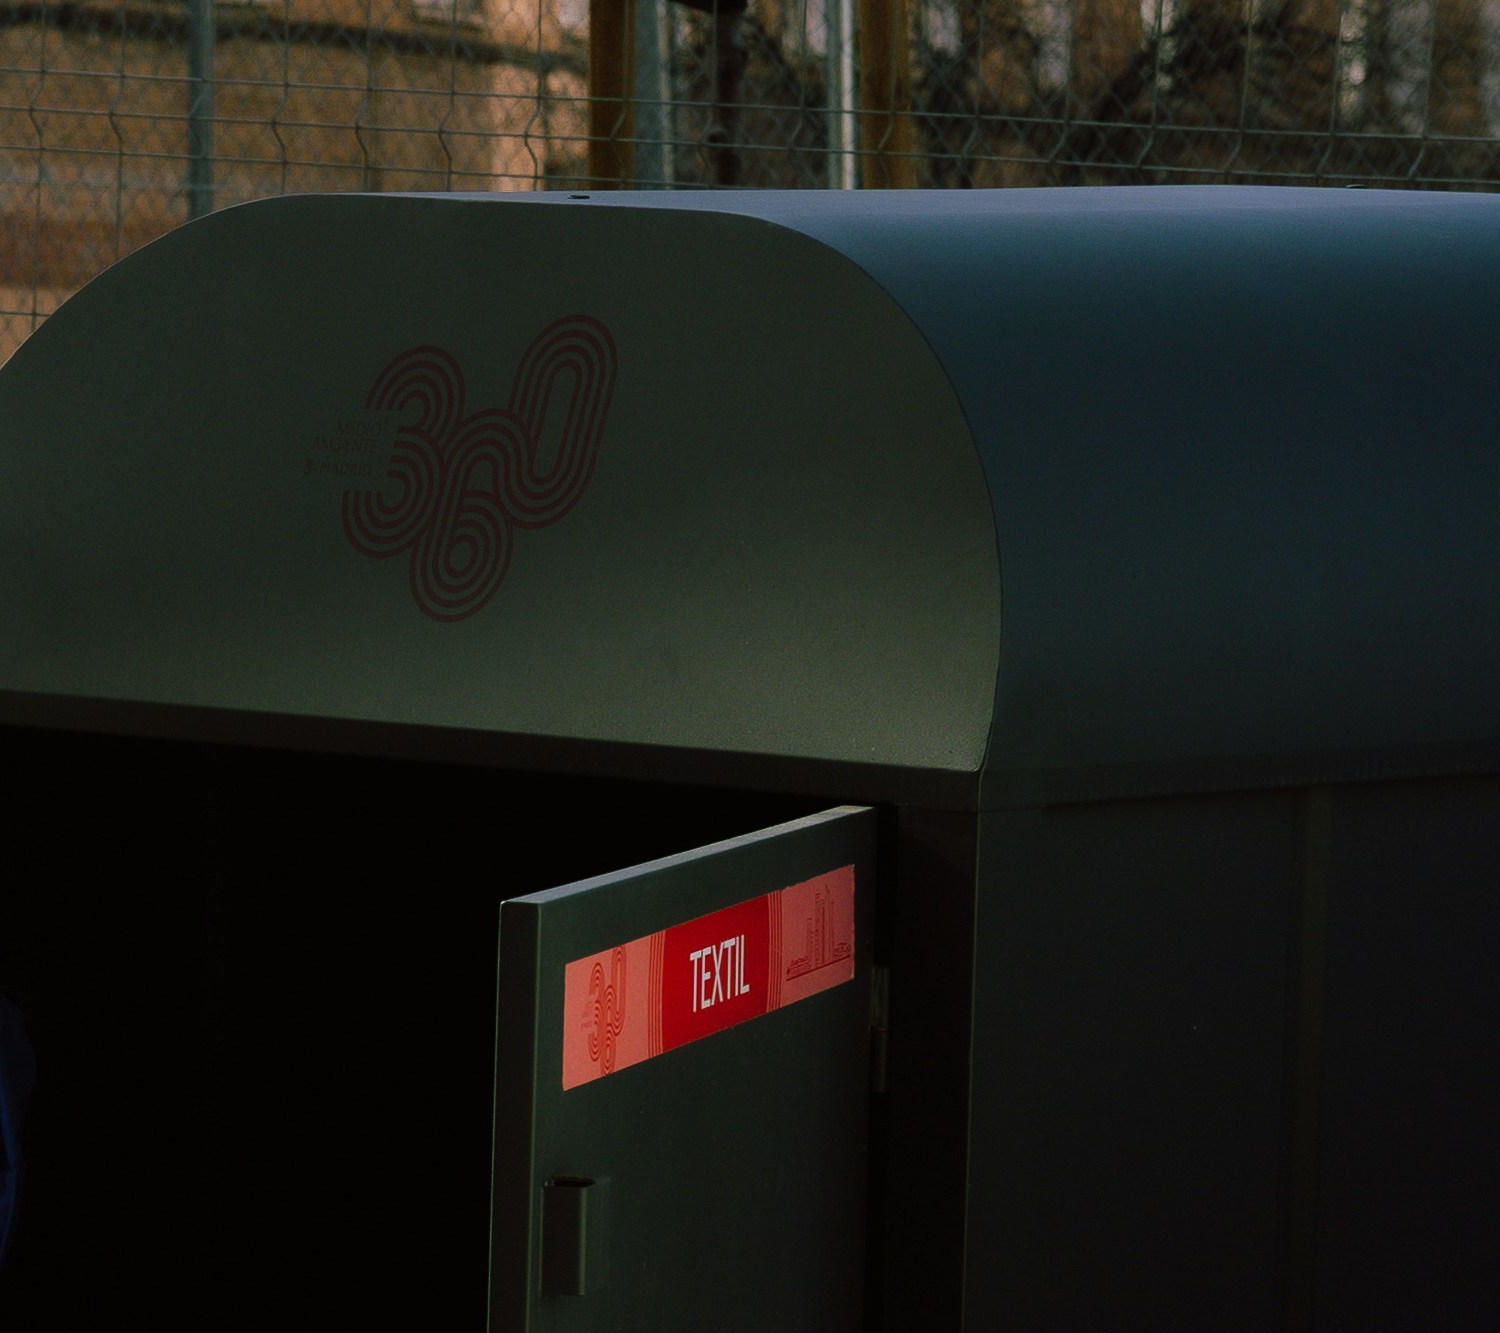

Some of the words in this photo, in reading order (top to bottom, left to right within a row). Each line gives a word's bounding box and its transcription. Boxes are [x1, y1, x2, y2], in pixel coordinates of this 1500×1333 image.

[335, 419, 382, 437] MEDIO
[318, 460, 372, 477] MADRID
[688, 933, 751, 1013] TEXTIL
